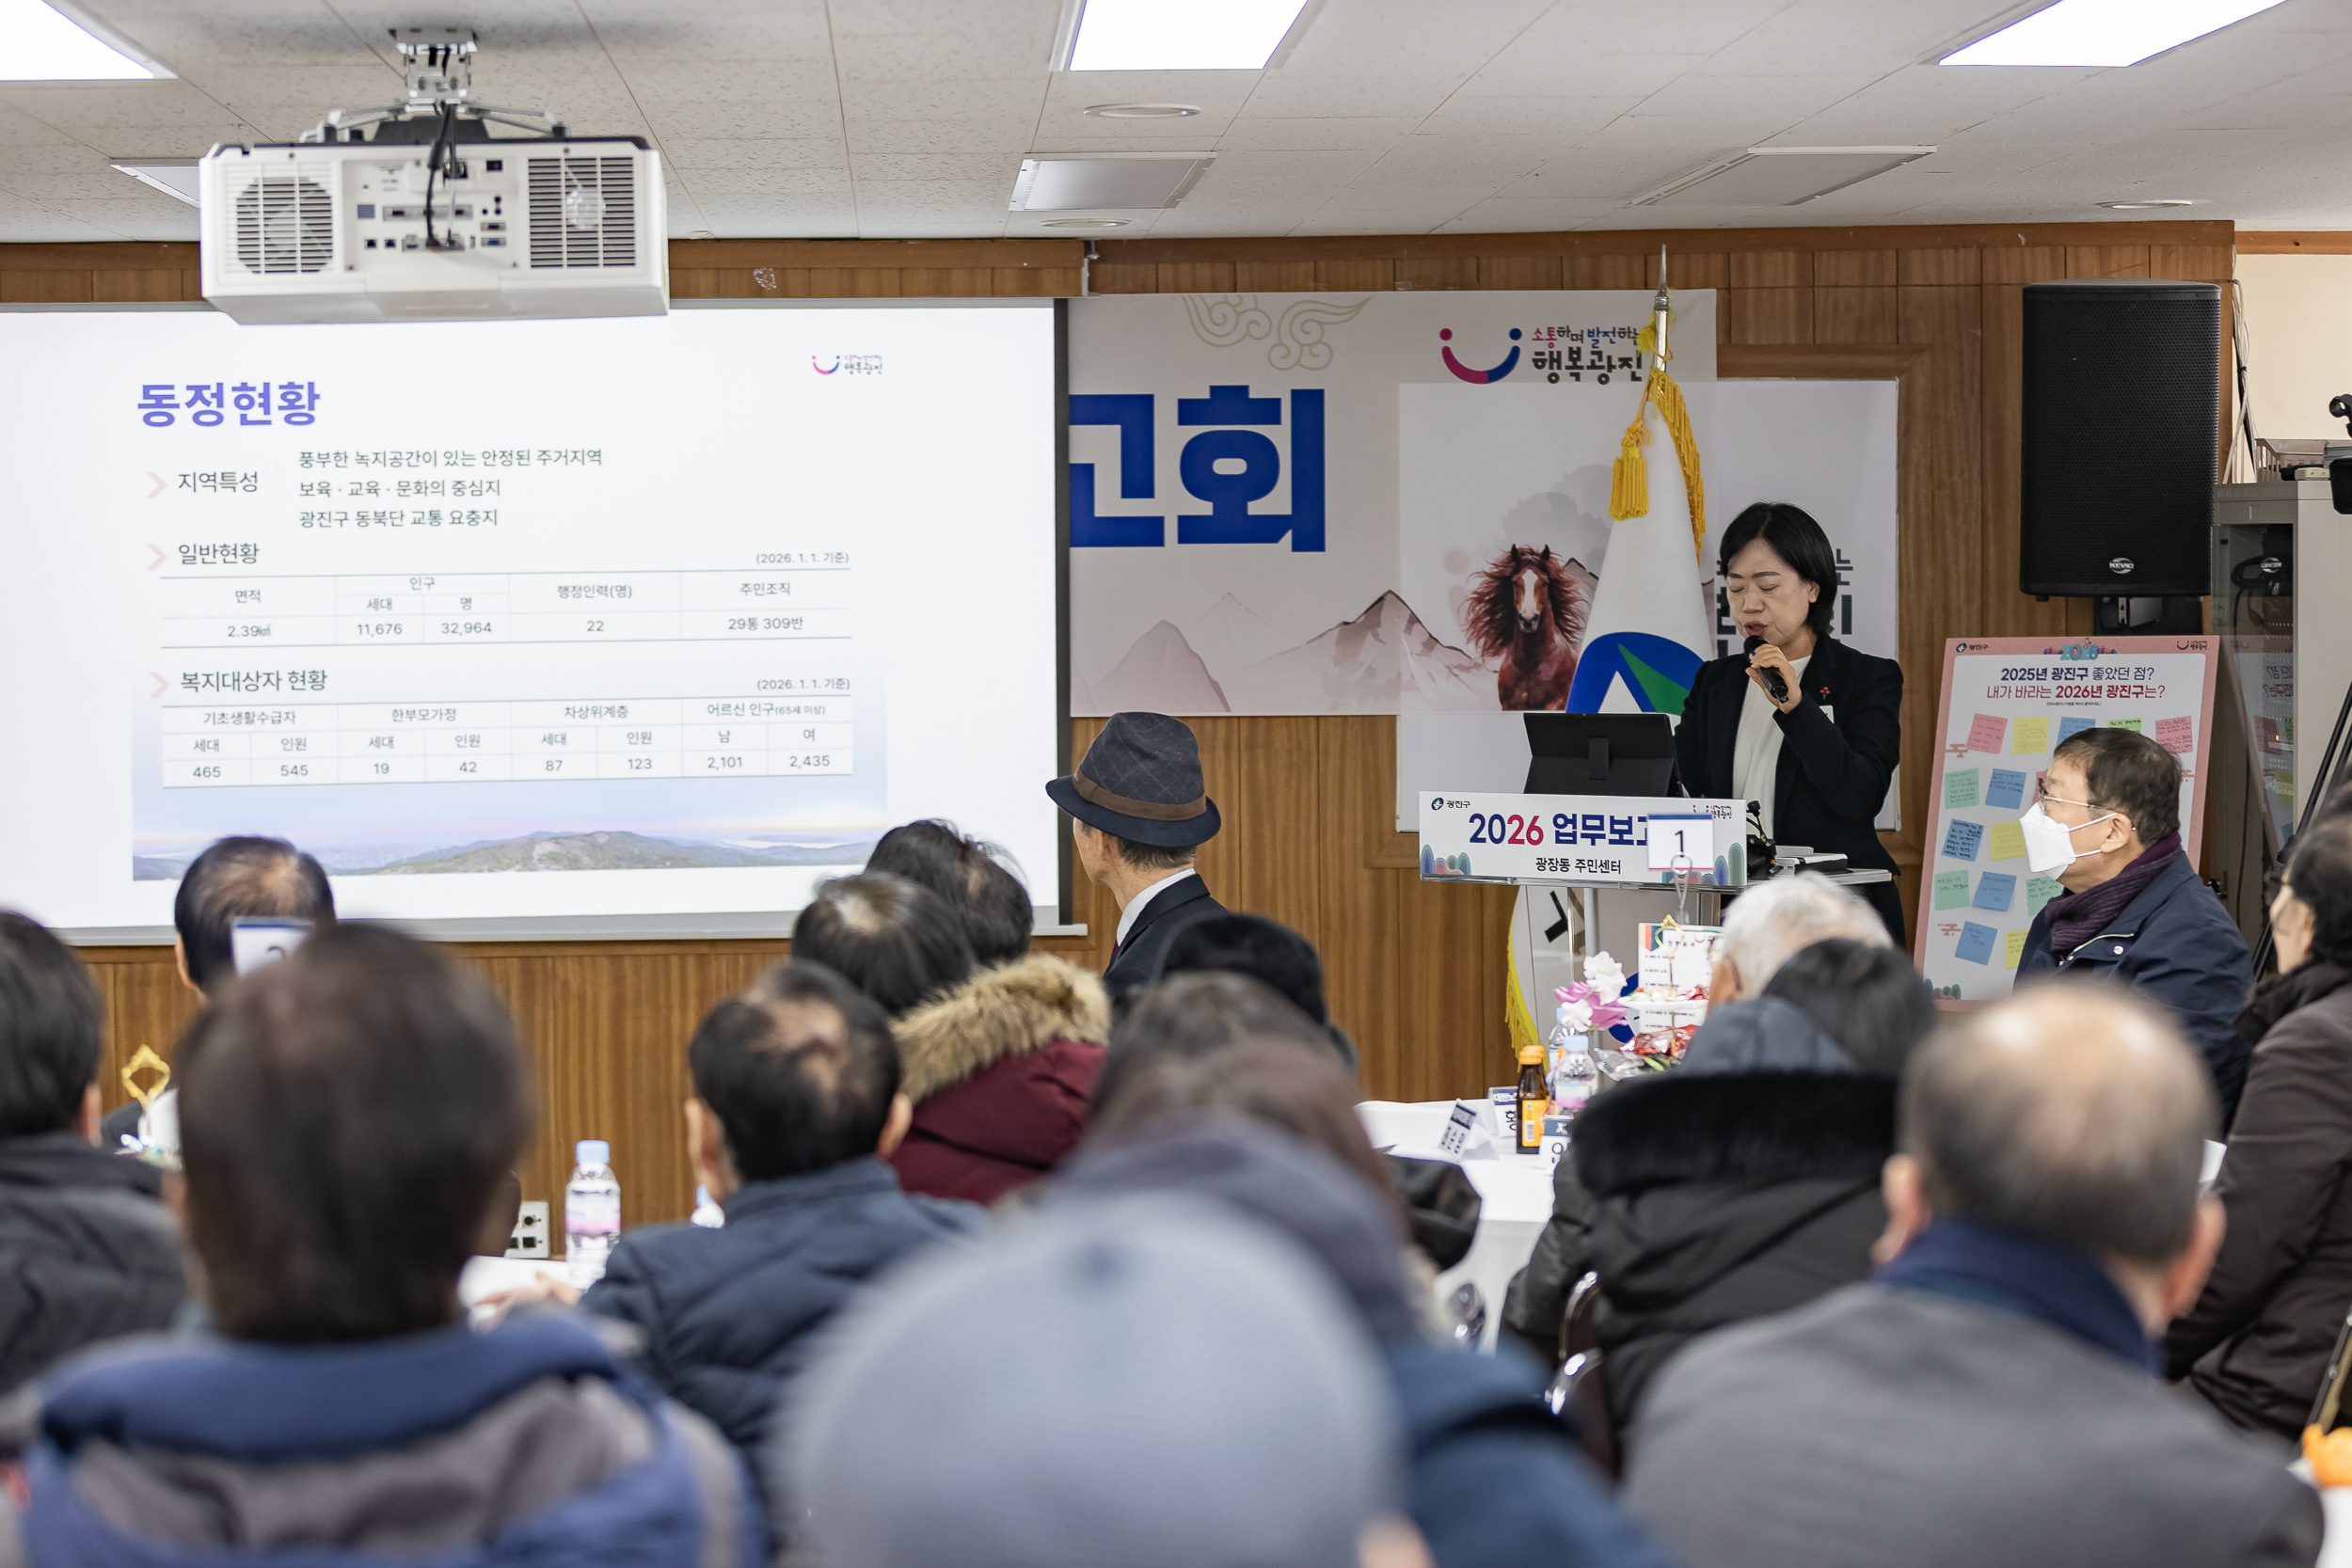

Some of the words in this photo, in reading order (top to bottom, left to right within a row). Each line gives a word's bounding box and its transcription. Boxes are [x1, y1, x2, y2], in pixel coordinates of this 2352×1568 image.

[1532, 325, 1584, 349] 소통하며
[1532, 346, 1643, 385] 행복광진
[137, 381, 321, 428] 동정현황
[298, 451, 349, 469] 풍부한
[354, 450, 437, 468] 녹지공간이
[443, 450, 477, 467] 있는
[481, 449, 531, 467] 안정된
[536, 449, 602, 467] 주거지역
[178, 470, 258, 493] 지역특성
[299, 481, 332, 498] 보육
[347, 480, 380, 498] 교육
[396, 480, 445, 498] 문화의
[452, 479, 501, 498] 중심지
[299, 511, 350, 529] 광진구
[355, 510, 405, 528] 동북단
[410, 509, 443, 527] 교통
[449, 509, 498, 527] 요충지
[178, 543, 260, 565] 일반현황
[408, 576, 436, 591] 인구
[739, 582, 790, 596] 주민조직
[234, 589, 261, 604] 면적
[557, 584, 633, 599] 행정인력(명)
[366, 597, 392, 611] 세대
[460, 596, 472, 610] 명
[357, 623, 403, 638] 11,676
[441, 622, 492, 636] 32,964
[586, 620, 604, 632] 22
[728, 617, 759, 631] 29통
[763, 616, 803, 630] 309반
[181, 670, 283, 693] 복지대상자
[287, 669, 328, 691] 현황
[2000, 667, 2048, 681] 2025년
[2051, 667, 2089, 681] 광진구
[2092, 667, 2130, 681] 좋았던
[2134, 667, 2155, 680] 점?
[1986, 685, 2012, 699] 내가
[2015, 685, 2053, 699] 바라는
[2055, 685, 2103, 699] 2026년
[2106, 685, 2166, 699] 광진구는?
[391, 707, 456, 723] 한부모가정
[564, 705, 628, 720] 차상위계층
[707, 703, 745, 717] 어르신
[203, 710, 296, 726] 기초생활수급자
[454, 734, 481, 749] 인원
[541, 733, 567, 746] 세대
[626, 731, 652, 746] 인원
[718, 729, 731, 744] 남
[803, 728, 816, 741] 여
[193, 738, 220, 752] 세대
[280, 736, 307, 752] 인원
[368, 736, 394, 750] 세대
[373, 762, 390, 775] 19
[458, 761, 477, 773] 42
[545, 759, 564, 772] 87
[628, 757, 653, 770] 123
[707, 756, 742, 771] 2,101
[789, 754, 831, 769] 2,435
[192, 766, 221, 779] 465
[280, 764, 309, 777] 545
[1446, 800, 1470, 809] 광진구
[1469, 813, 1544, 846] 2026
[1675, 830, 1684, 857] 1
[1535, 857, 1571, 873] 광장동
[1574, 858, 1621, 875] 주민센터
